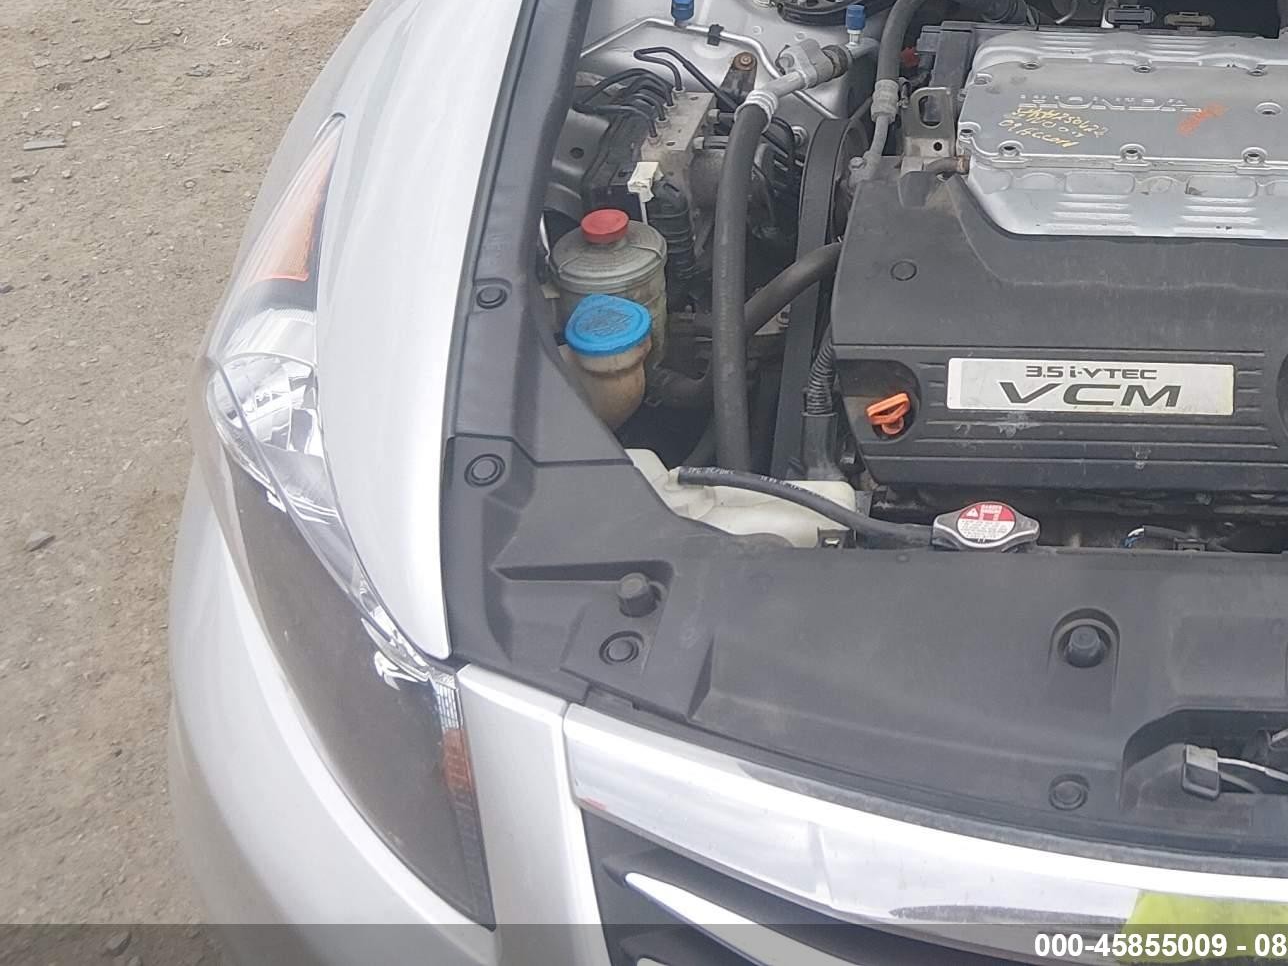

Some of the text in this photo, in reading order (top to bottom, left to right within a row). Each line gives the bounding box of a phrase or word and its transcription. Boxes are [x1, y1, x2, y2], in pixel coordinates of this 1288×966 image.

[1026, 365, 1158, 380] 3.5 i-VTEC
[999, 381, 1182, 408] VCM
